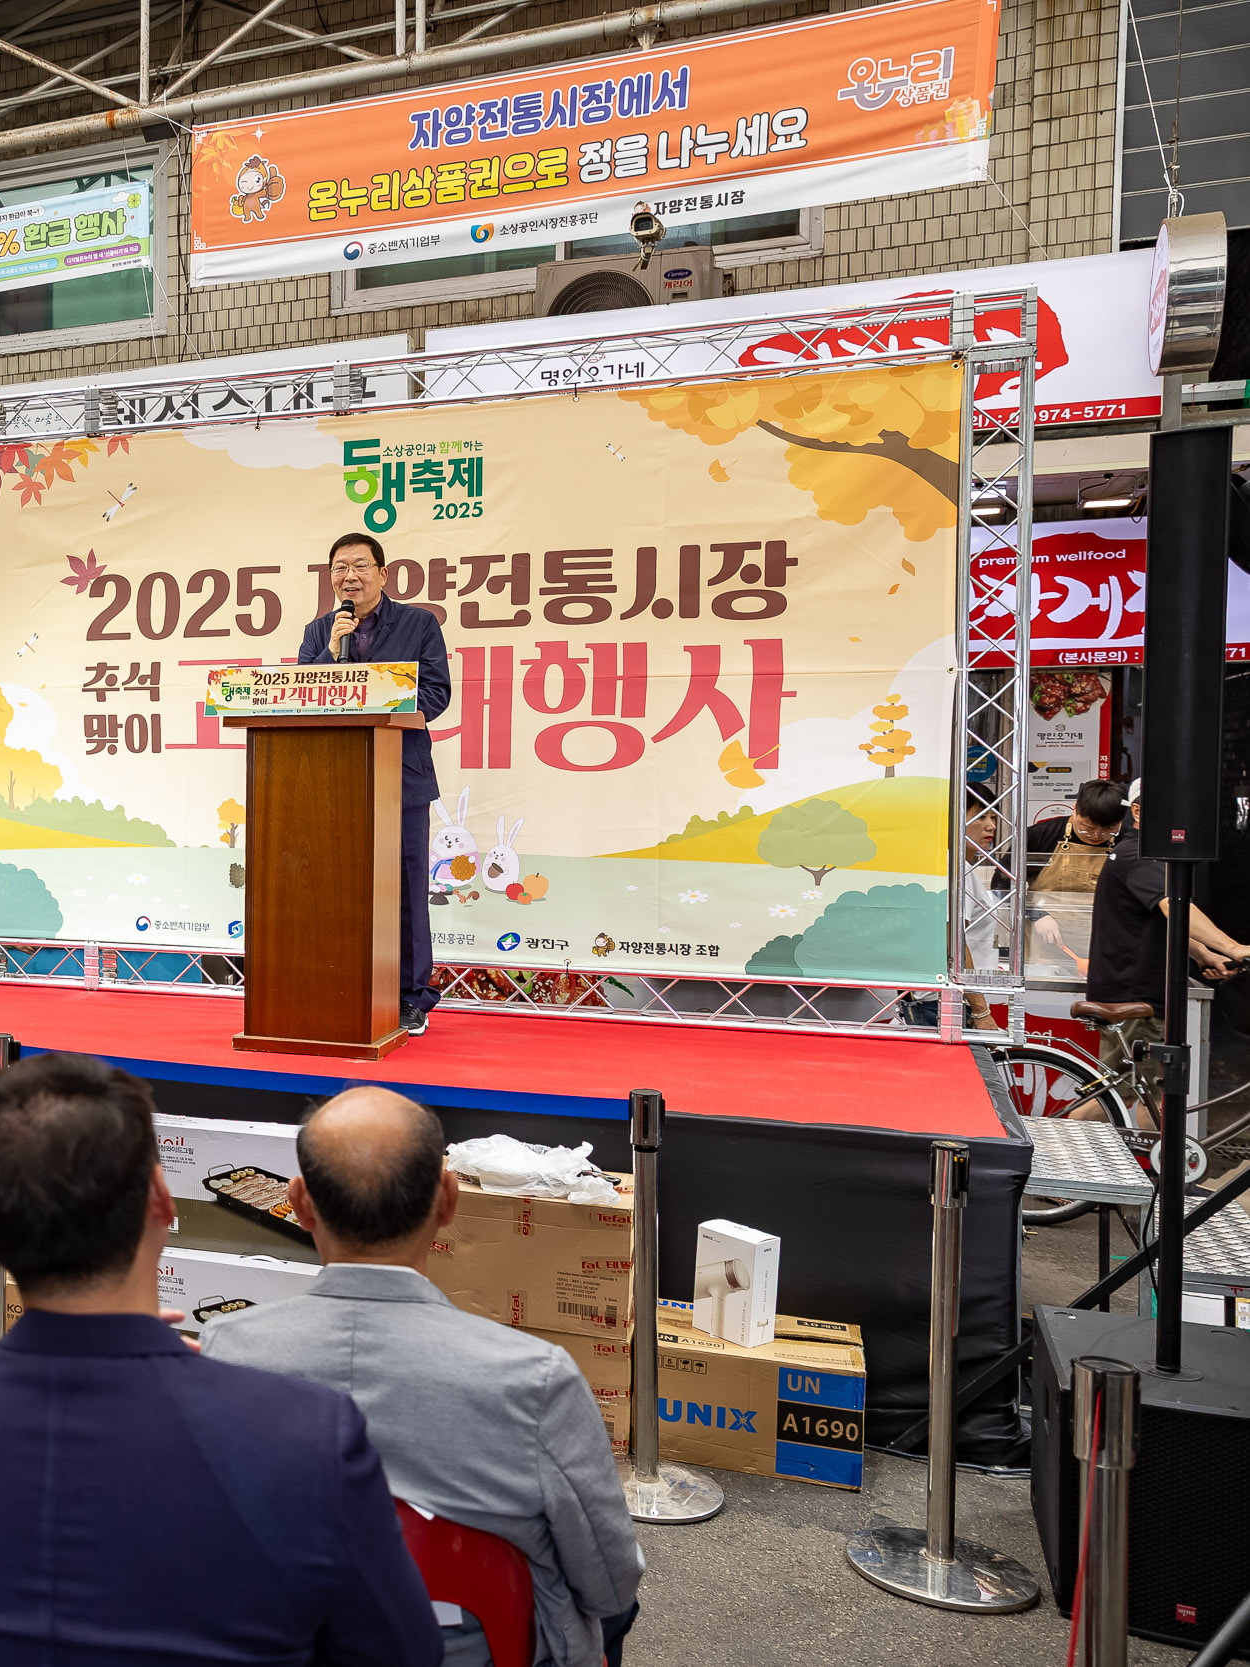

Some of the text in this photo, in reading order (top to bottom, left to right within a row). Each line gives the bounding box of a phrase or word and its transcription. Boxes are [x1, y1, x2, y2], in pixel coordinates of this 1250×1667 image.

[896, 80, 951, 106] 상품권
[408, 65, 691, 150] 자양전통시장에서
[308, 107, 808, 222] 온누리상품권으로 정을 나누세요
[654, 190, 746, 216] 자양전통시장
[24, 219, 71, 252] 환급
[74, 208, 126, 240] 행사
[499, 212, 599, 235] 소상공인시장진흥공단
[367, 234, 441, 255] 중소벤처기업부
[663, 279, 693, 290] 캐리어
[382, 440, 483, 458] 소상공인과 함께하는
[432, 501, 483, 521] 2025
[1055, 549, 1126, 562] wellfood
[85, 564, 282, 642] 2025
[82, 661, 161, 703] 추석
[253, 670, 370, 686] 2025 자양전통시장
[267, 685, 369, 707] 고객대행사
[83, 712, 161, 756] 맞이
[154, 919, 210, 933] 중소벤처기업부
[525, 937, 569, 951] 광진구
[618, 940, 720, 957] 자양전통시장 조합
[596, 1213, 632, 1225] Tefal
[681, 1339, 721, 1350] A1690
[786, 1373, 821, 1396] UN
[781, 1413, 859, 1443] A1690
